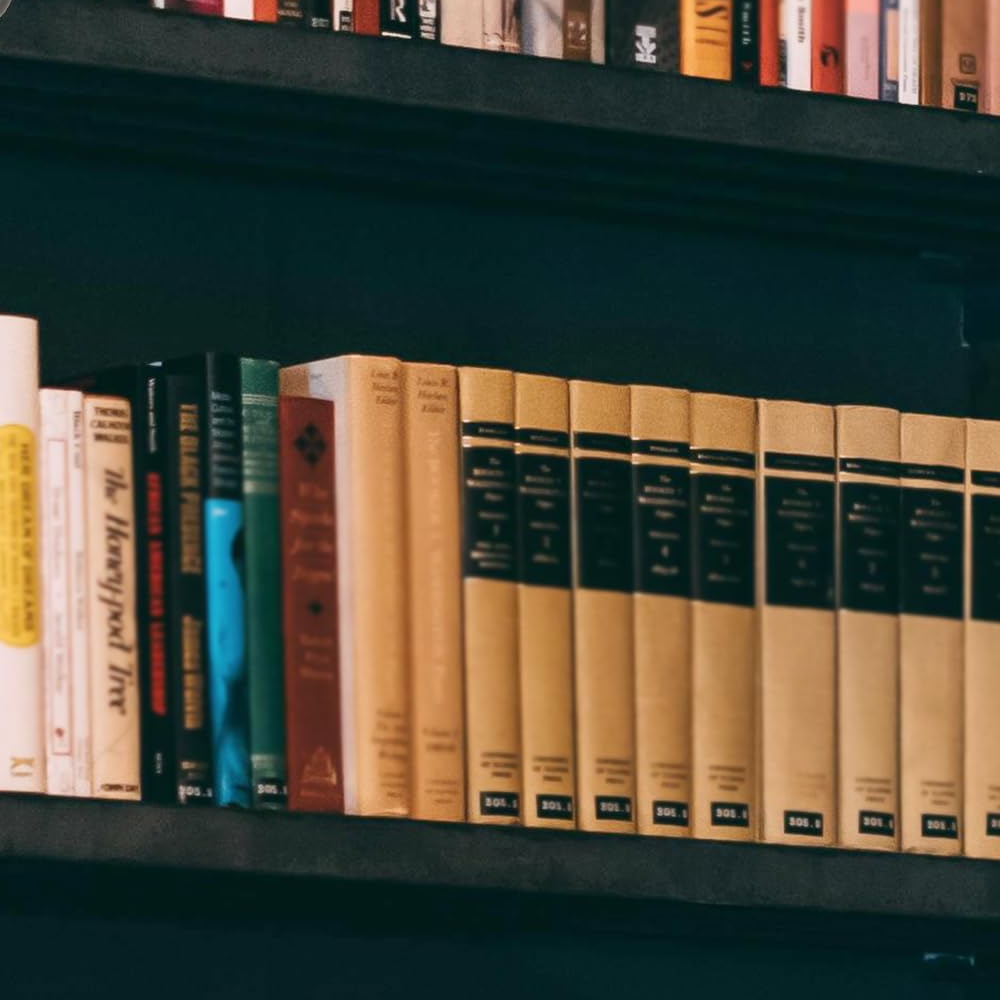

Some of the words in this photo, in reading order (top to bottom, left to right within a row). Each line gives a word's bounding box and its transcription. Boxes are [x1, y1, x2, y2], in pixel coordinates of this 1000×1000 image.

[741, 2, 752, 46] Smith
[797, 6, 808, 44] Smith
[179, 403, 198, 432] THE
[20, 442, 33, 475] HER
[179, 435, 199, 488] BLACK
[20, 479, 34, 539] DREAM
[103, 467, 131, 506] The
[146, 472, 162, 536] AFRICAN
[21, 543, 34, 561] OF
[180, 492, 202, 575] PRESENCE
[21, 564, 35, 633] DREAMS
[96, 514, 134, 651] Honey-pod
[147, 540, 164, 616] AMERICAN
[107, 661, 137, 716] Tree
[148, 622, 167, 716] LEADERSHIP
